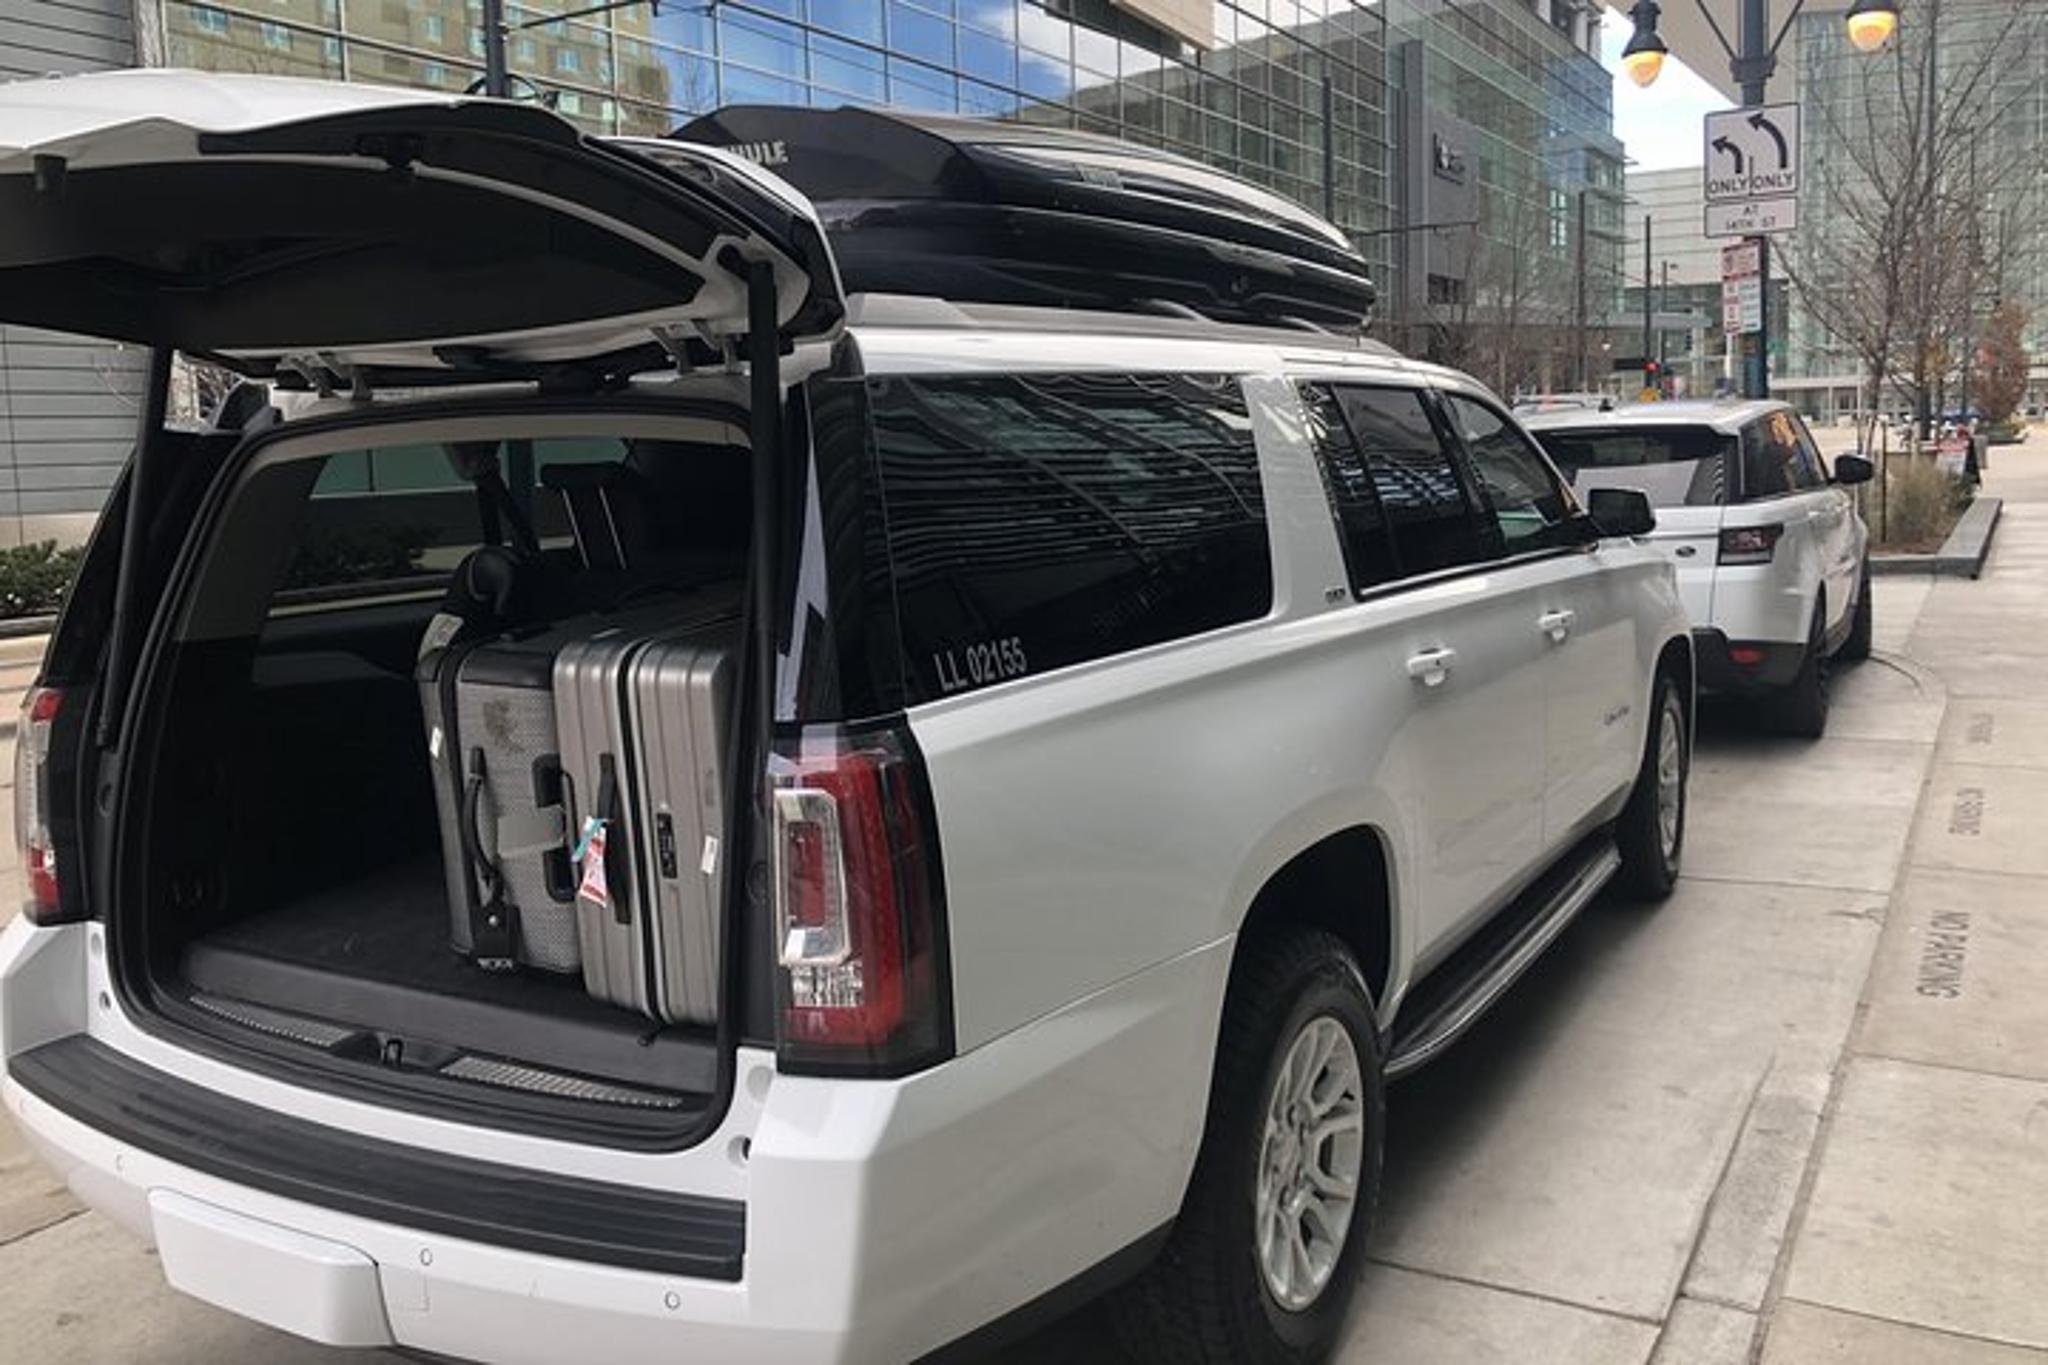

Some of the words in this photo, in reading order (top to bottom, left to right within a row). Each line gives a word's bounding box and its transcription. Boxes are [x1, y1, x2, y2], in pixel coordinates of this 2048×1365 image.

[1708, 179, 1748, 194] ONLY
[1752, 173, 1794, 190] ONLY
[1744, 204, 1760, 215] AT
[932, 651, 968, 692] LL
[966, 636, 1028, 684] 02155
[1930, 910, 1970, 931] NO
[1916, 932, 1969, 999] PARKING
